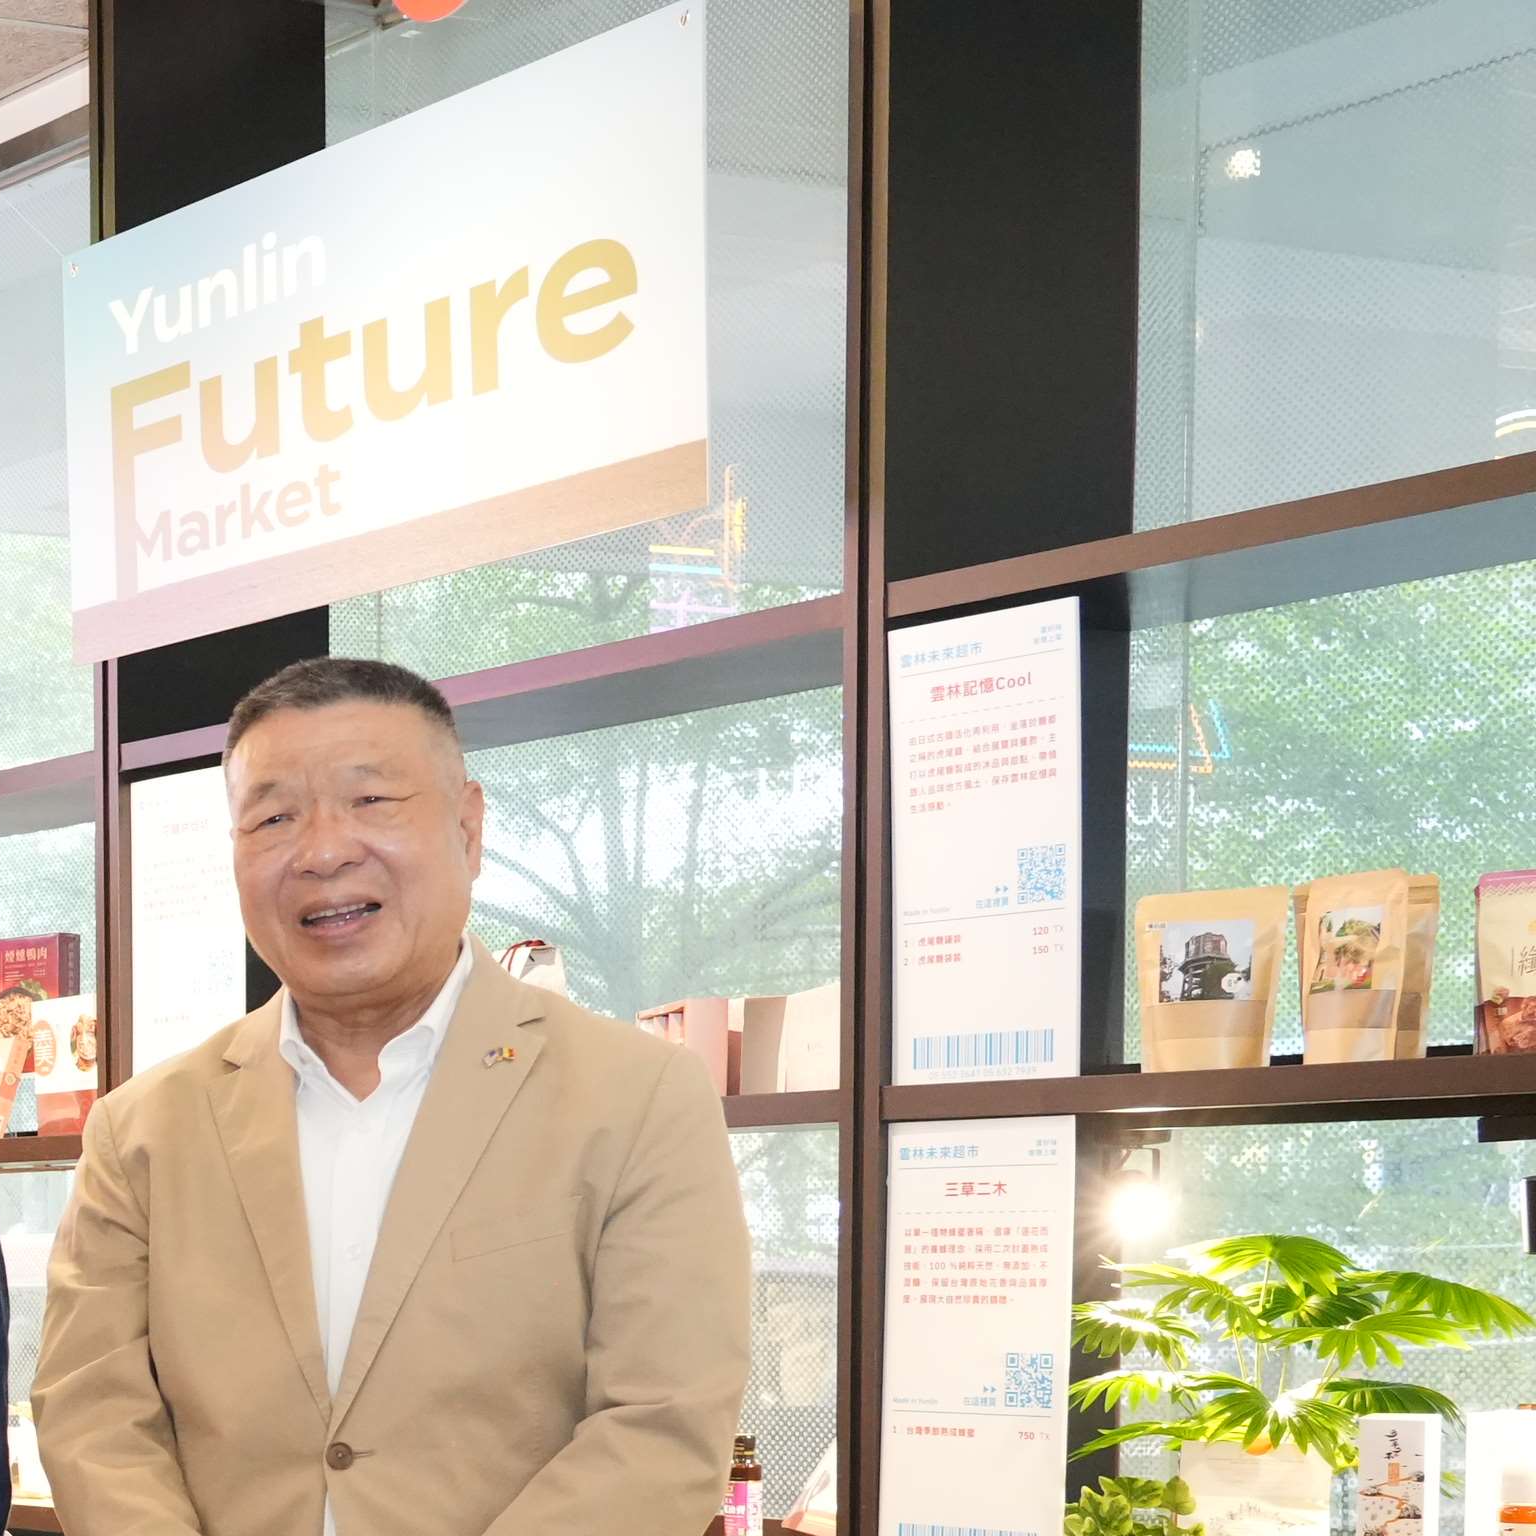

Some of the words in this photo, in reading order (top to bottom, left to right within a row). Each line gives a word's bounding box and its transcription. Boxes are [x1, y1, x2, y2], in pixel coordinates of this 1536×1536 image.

[108, 232, 327, 356] Yunlin
[111, 238, 639, 600] Future
[134, 463, 343, 562] Market
[900, 642, 983, 668] 雲林未來超市
[930, 672, 1032, 702] 雲林記憶Cool
[1032, 926, 1049, 935] 120
[1032, 945, 1049, 955] 150
[900, 1145, 979, 1160] 雲林未來超市
[944, 1180, 1008, 1197] 三草二木
[1018, 1431, 1035, 1440] 750
